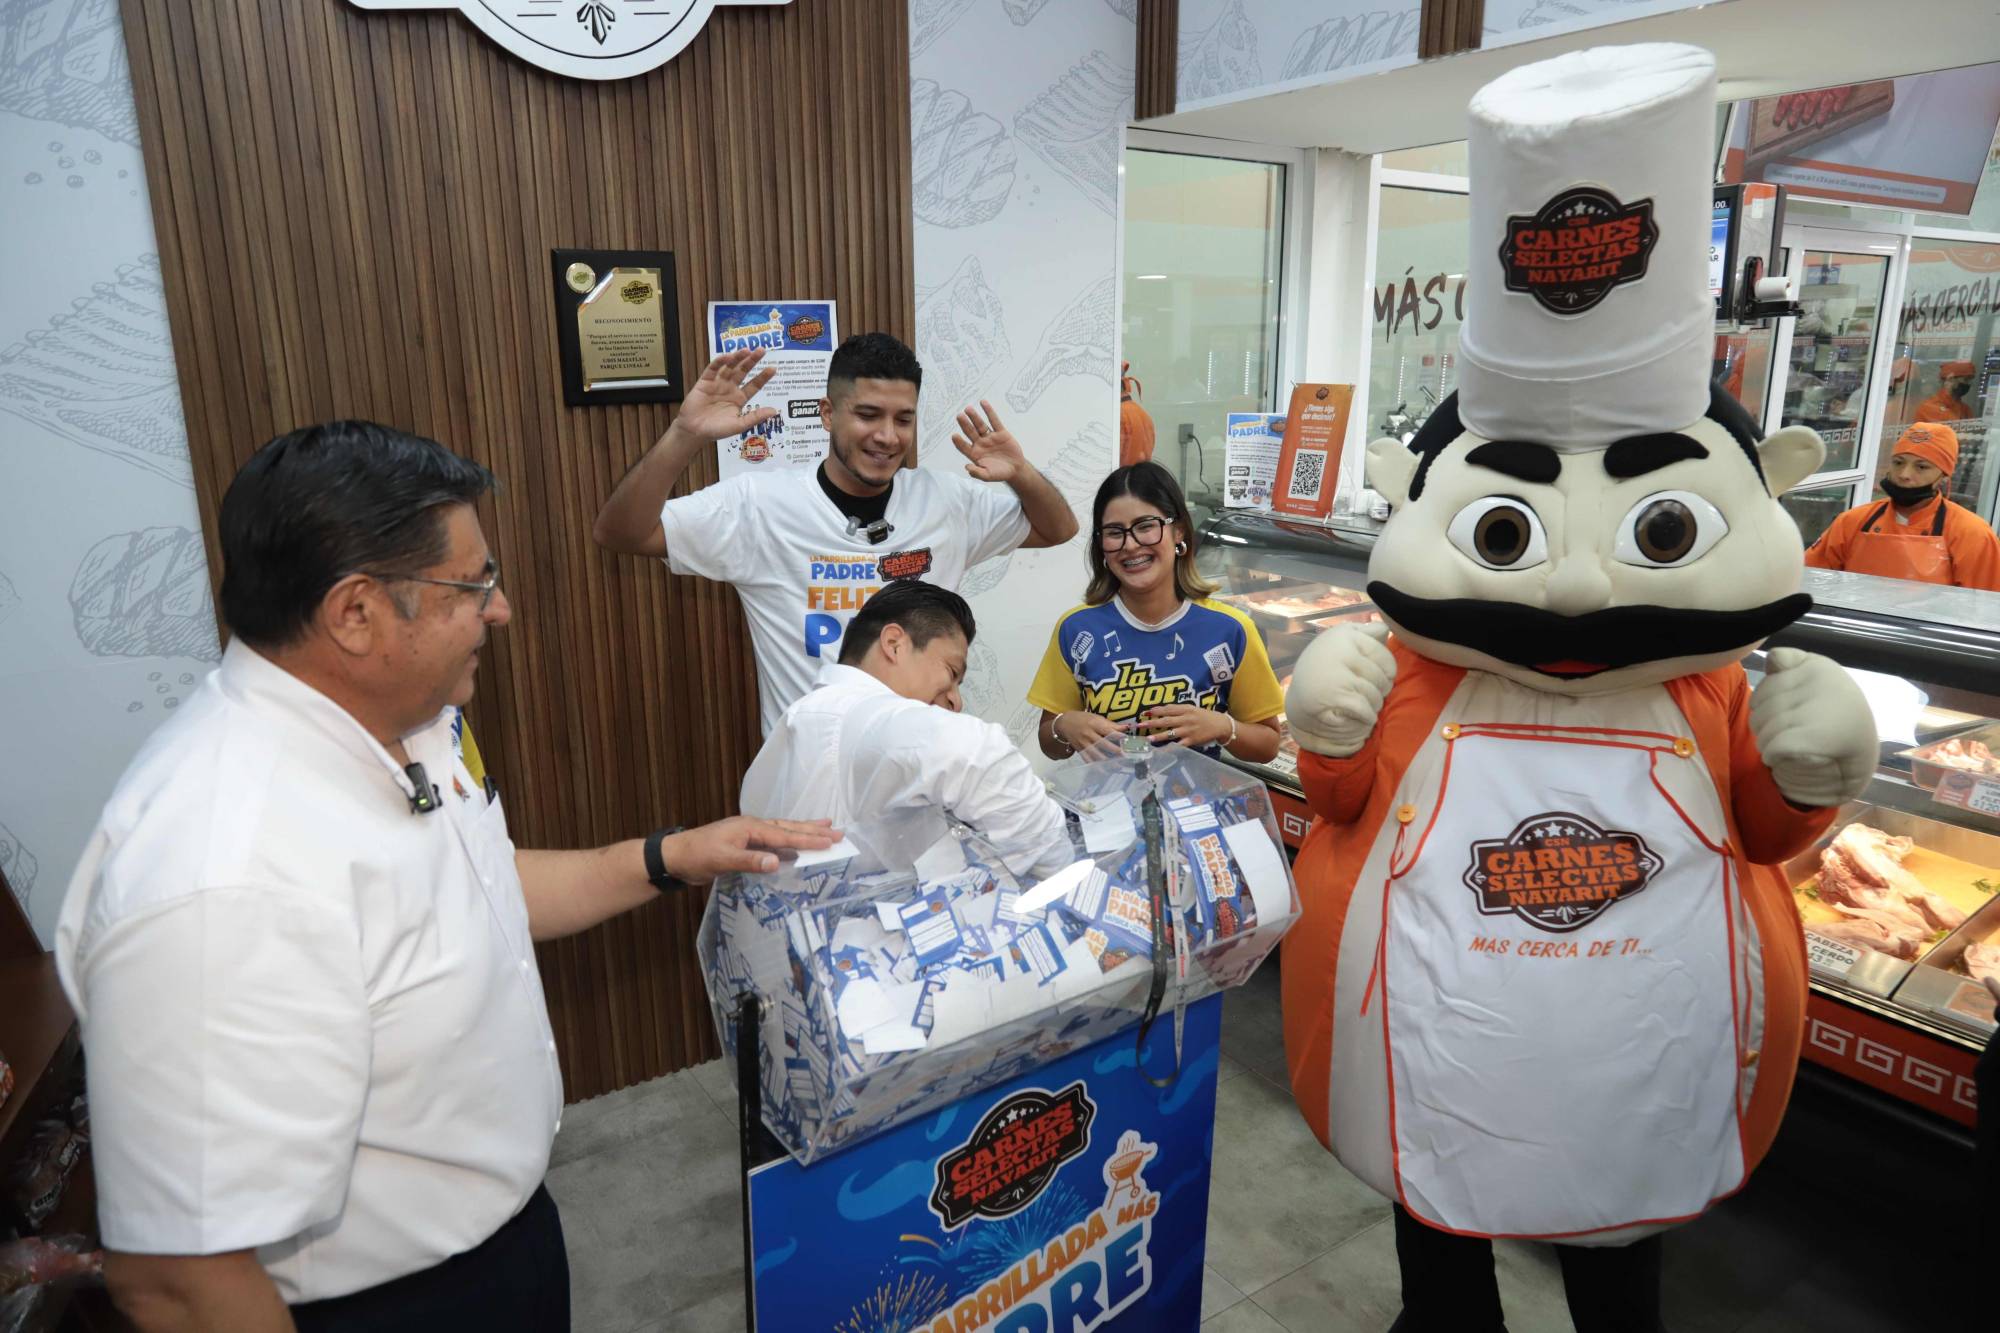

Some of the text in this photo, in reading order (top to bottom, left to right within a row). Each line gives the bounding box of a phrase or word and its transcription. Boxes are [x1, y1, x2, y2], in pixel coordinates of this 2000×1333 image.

[1515, 216, 1641, 249] CARNES
[1514, 238, 1640, 266] SELECTAS
[1527, 261, 1622, 283] NAYARIT
[1374, 266, 1447, 343] MÁS
[1932, 277, 1989, 326] CERCA
[729, 323, 772, 337] PARRILLADA
[790, 323, 821, 333] CARNES
[724, 331, 783, 352] PADRE
[792, 405, 820, 417] ganar?
[1232, 427, 1268, 438] PADRE
[884, 551, 928, 566] CARNES
[884, 559, 928, 573] SELECTAS
[811, 563, 876, 580] PADRE
[892, 566, 923, 577] NAYARIT
[1119, 665, 1151, 688] la
[1085, 680, 1187, 720] Mejor
[1179, 692, 1192, 700] FM
[1544, 837, 1570, 846] CSN
[1487, 843, 1636, 874] CARNES
[1487, 864, 1639, 892] SELECTAS
[1509, 885, 1620, 906] NAYARIT
[1517, 939, 1578, 958] CERCA
[1587, 939, 1616, 957] DE
[1807, 933, 1853, 956] CABEZA
[1812, 945, 1854, 965] CERDO
[951, 1100, 1072, 1182] CARNES
[953, 1119, 1075, 1200] SELECTAS
[970, 1143, 1061, 1206] NAYARIT
[913, 1195, 1157, 1333] ARRILLADA MÁS
